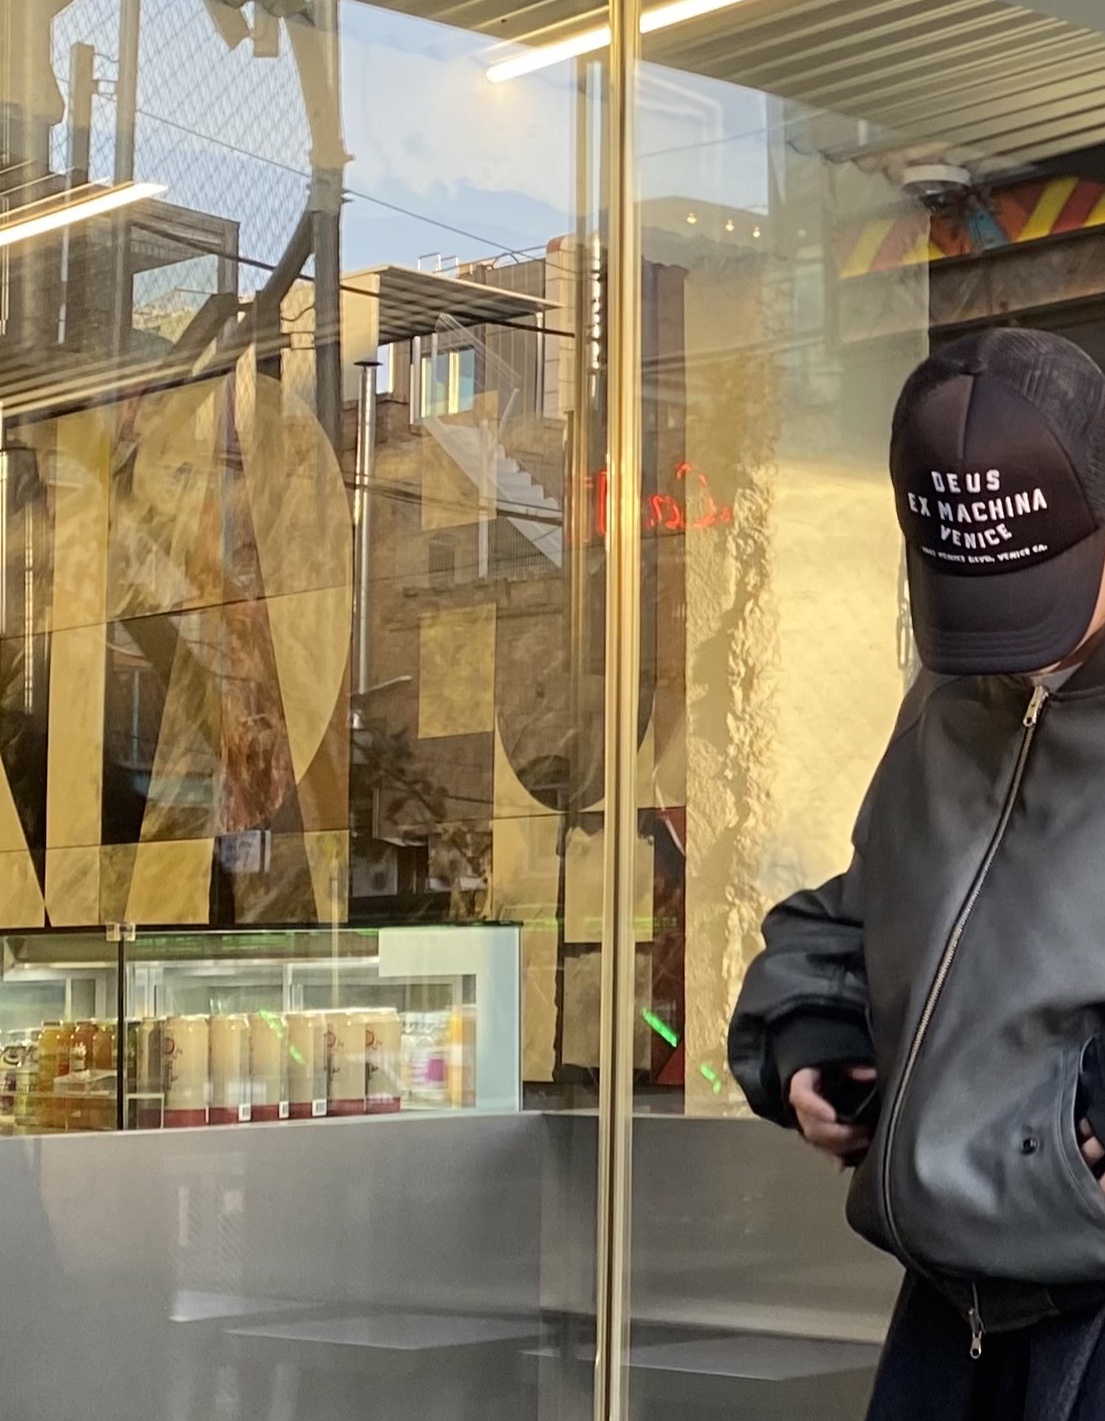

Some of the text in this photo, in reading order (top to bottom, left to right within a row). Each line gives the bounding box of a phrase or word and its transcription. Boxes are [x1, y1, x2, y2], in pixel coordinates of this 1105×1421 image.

[930, 468, 1001, 493] DEUS
[906, 487, 1049, 524] EX MACHINA
[940, 522, 1014, 549] VENICE
